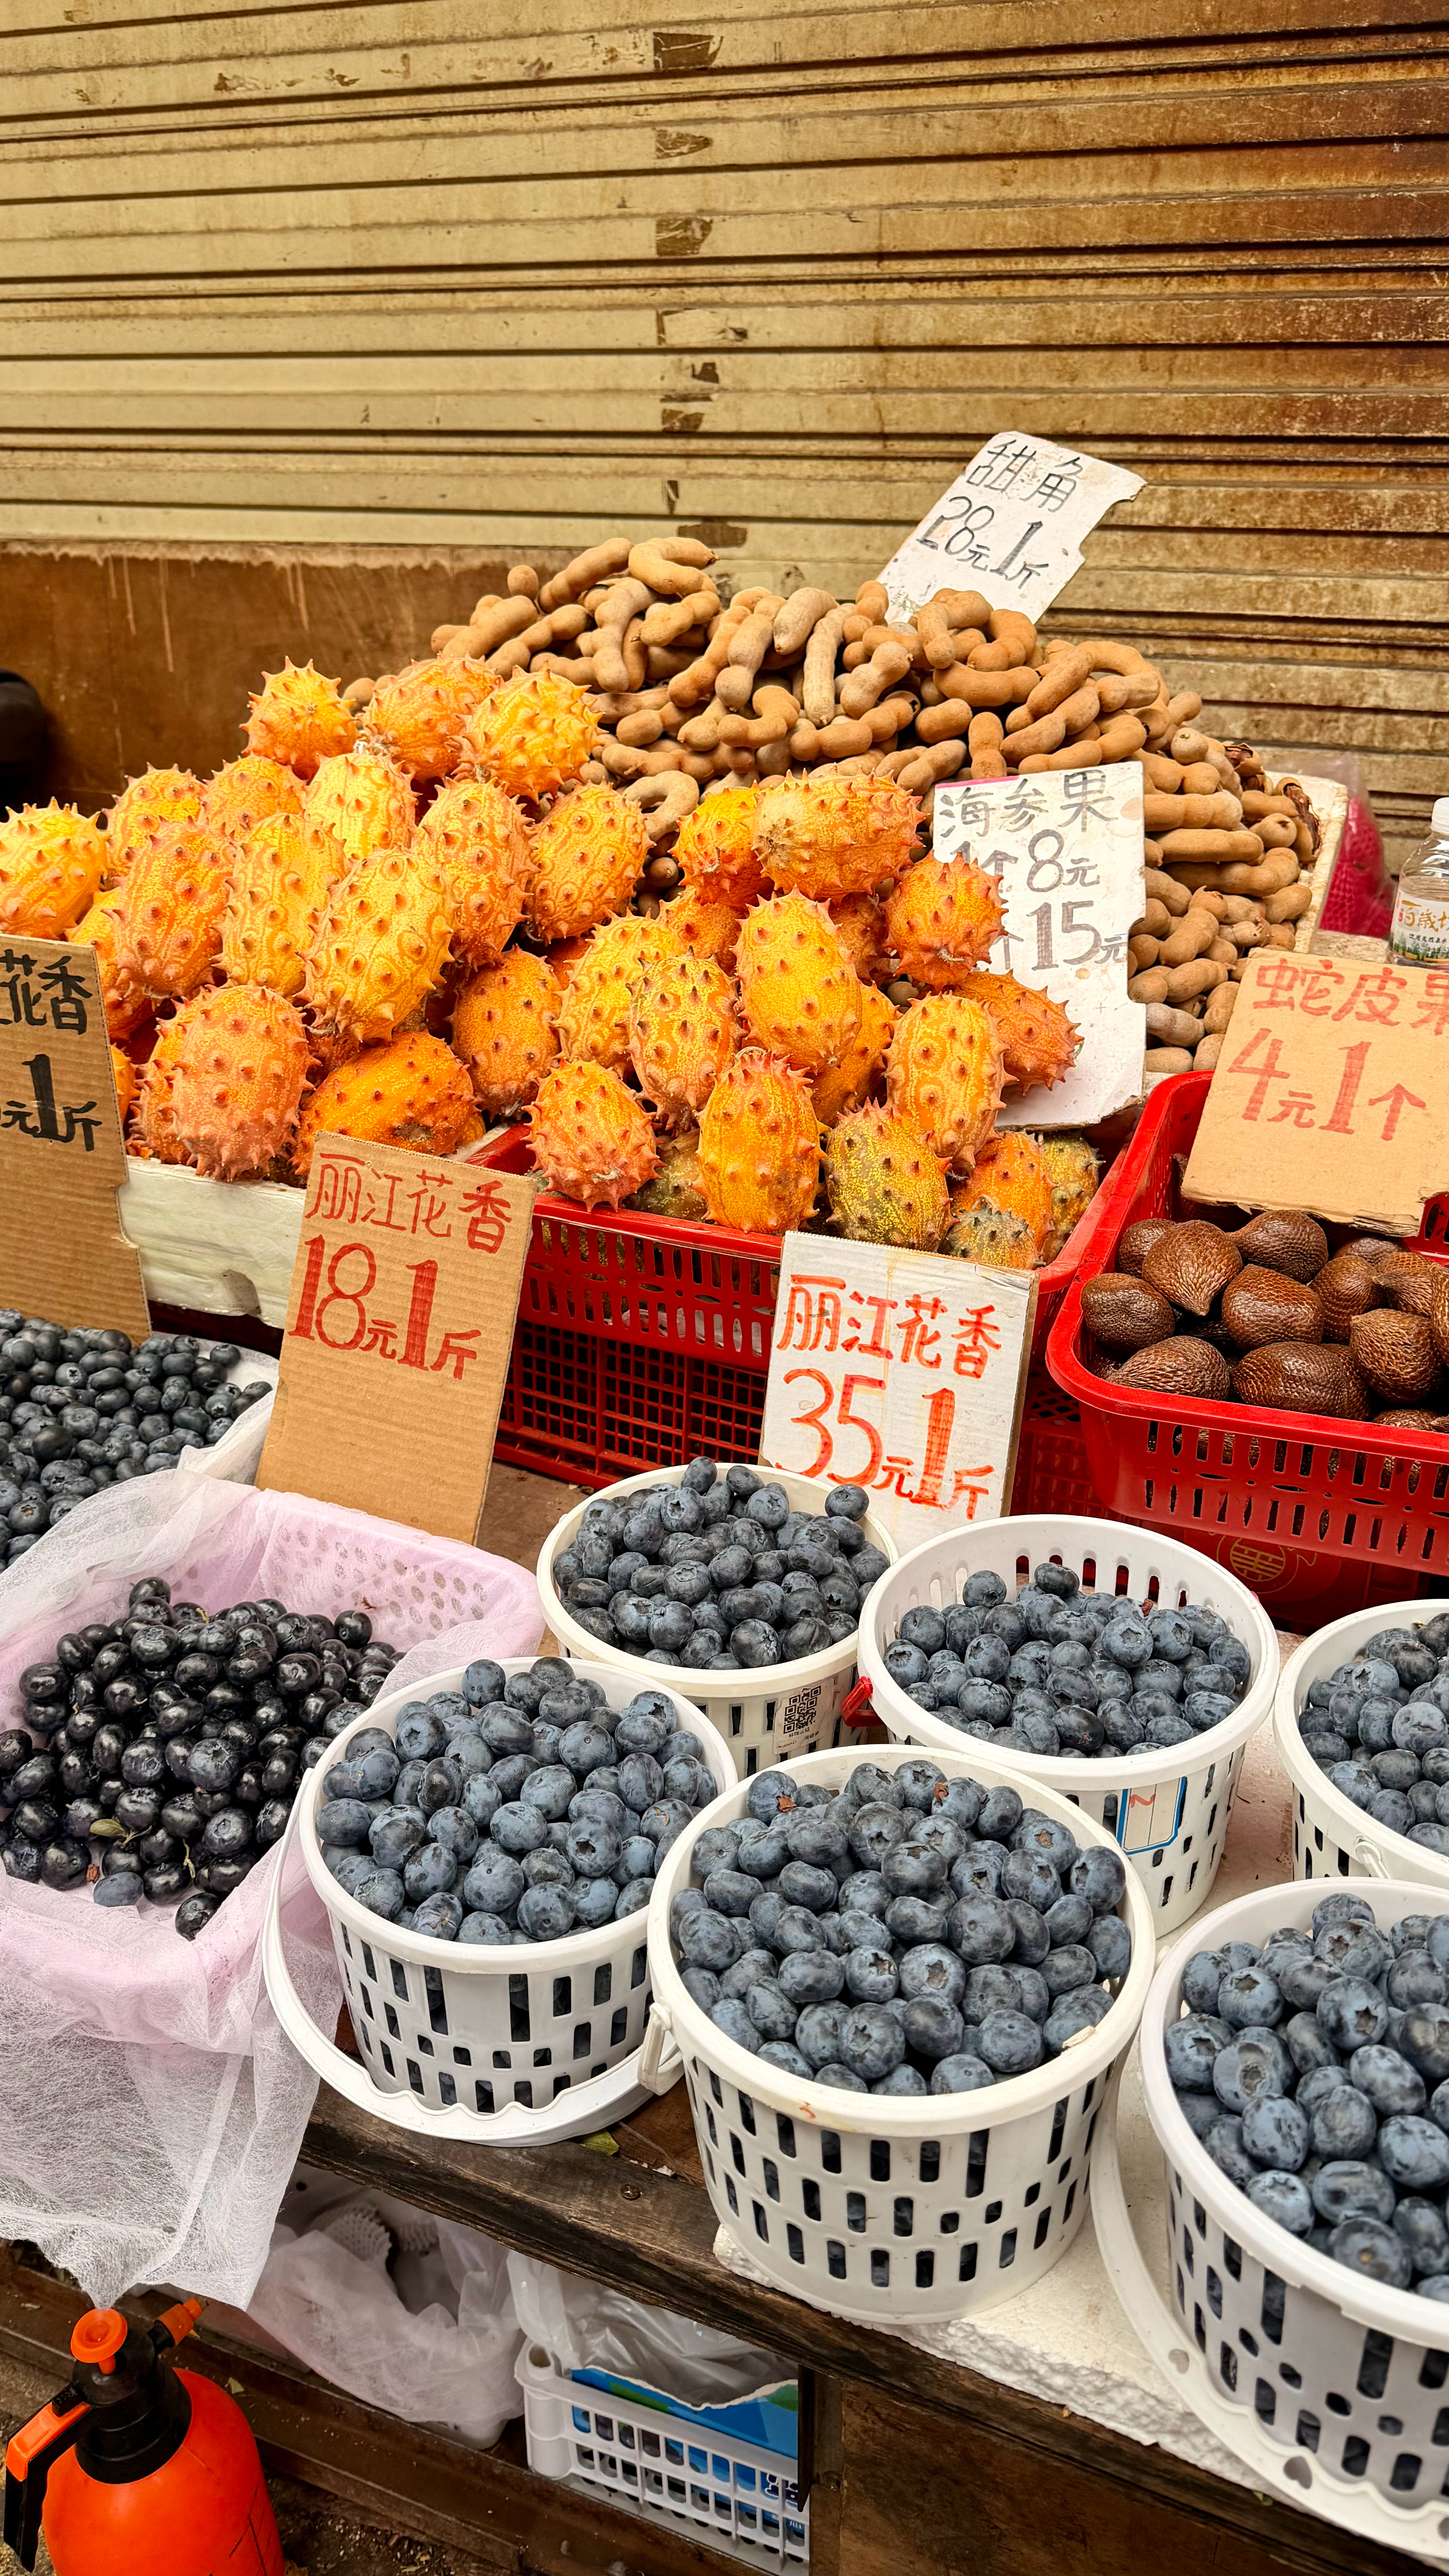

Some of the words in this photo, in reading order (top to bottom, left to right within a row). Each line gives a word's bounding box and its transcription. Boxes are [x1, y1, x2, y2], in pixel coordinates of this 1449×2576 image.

[966, 439, 1083, 513] 甜角
[916, 495, 1049, 589] 28元1斤
[939, 769, 1118, 838] 海参果
[972, 900, 1127, 971] 个15元
[0, 948, 93, 1035] 花香
[1252, 958, 1449, 1036] 蛇皮果
[0, 1053, 103, 1152] 元1斤
[1226, 1028, 1427, 1141] 4元1个
[304, 1152, 512, 1254] 丽江花香
[287, 1234, 482, 1380] 18元1斤
[776, 1274, 1002, 1379] 丽江花香
[775, 1368, 995, 1520] 35元1斤
